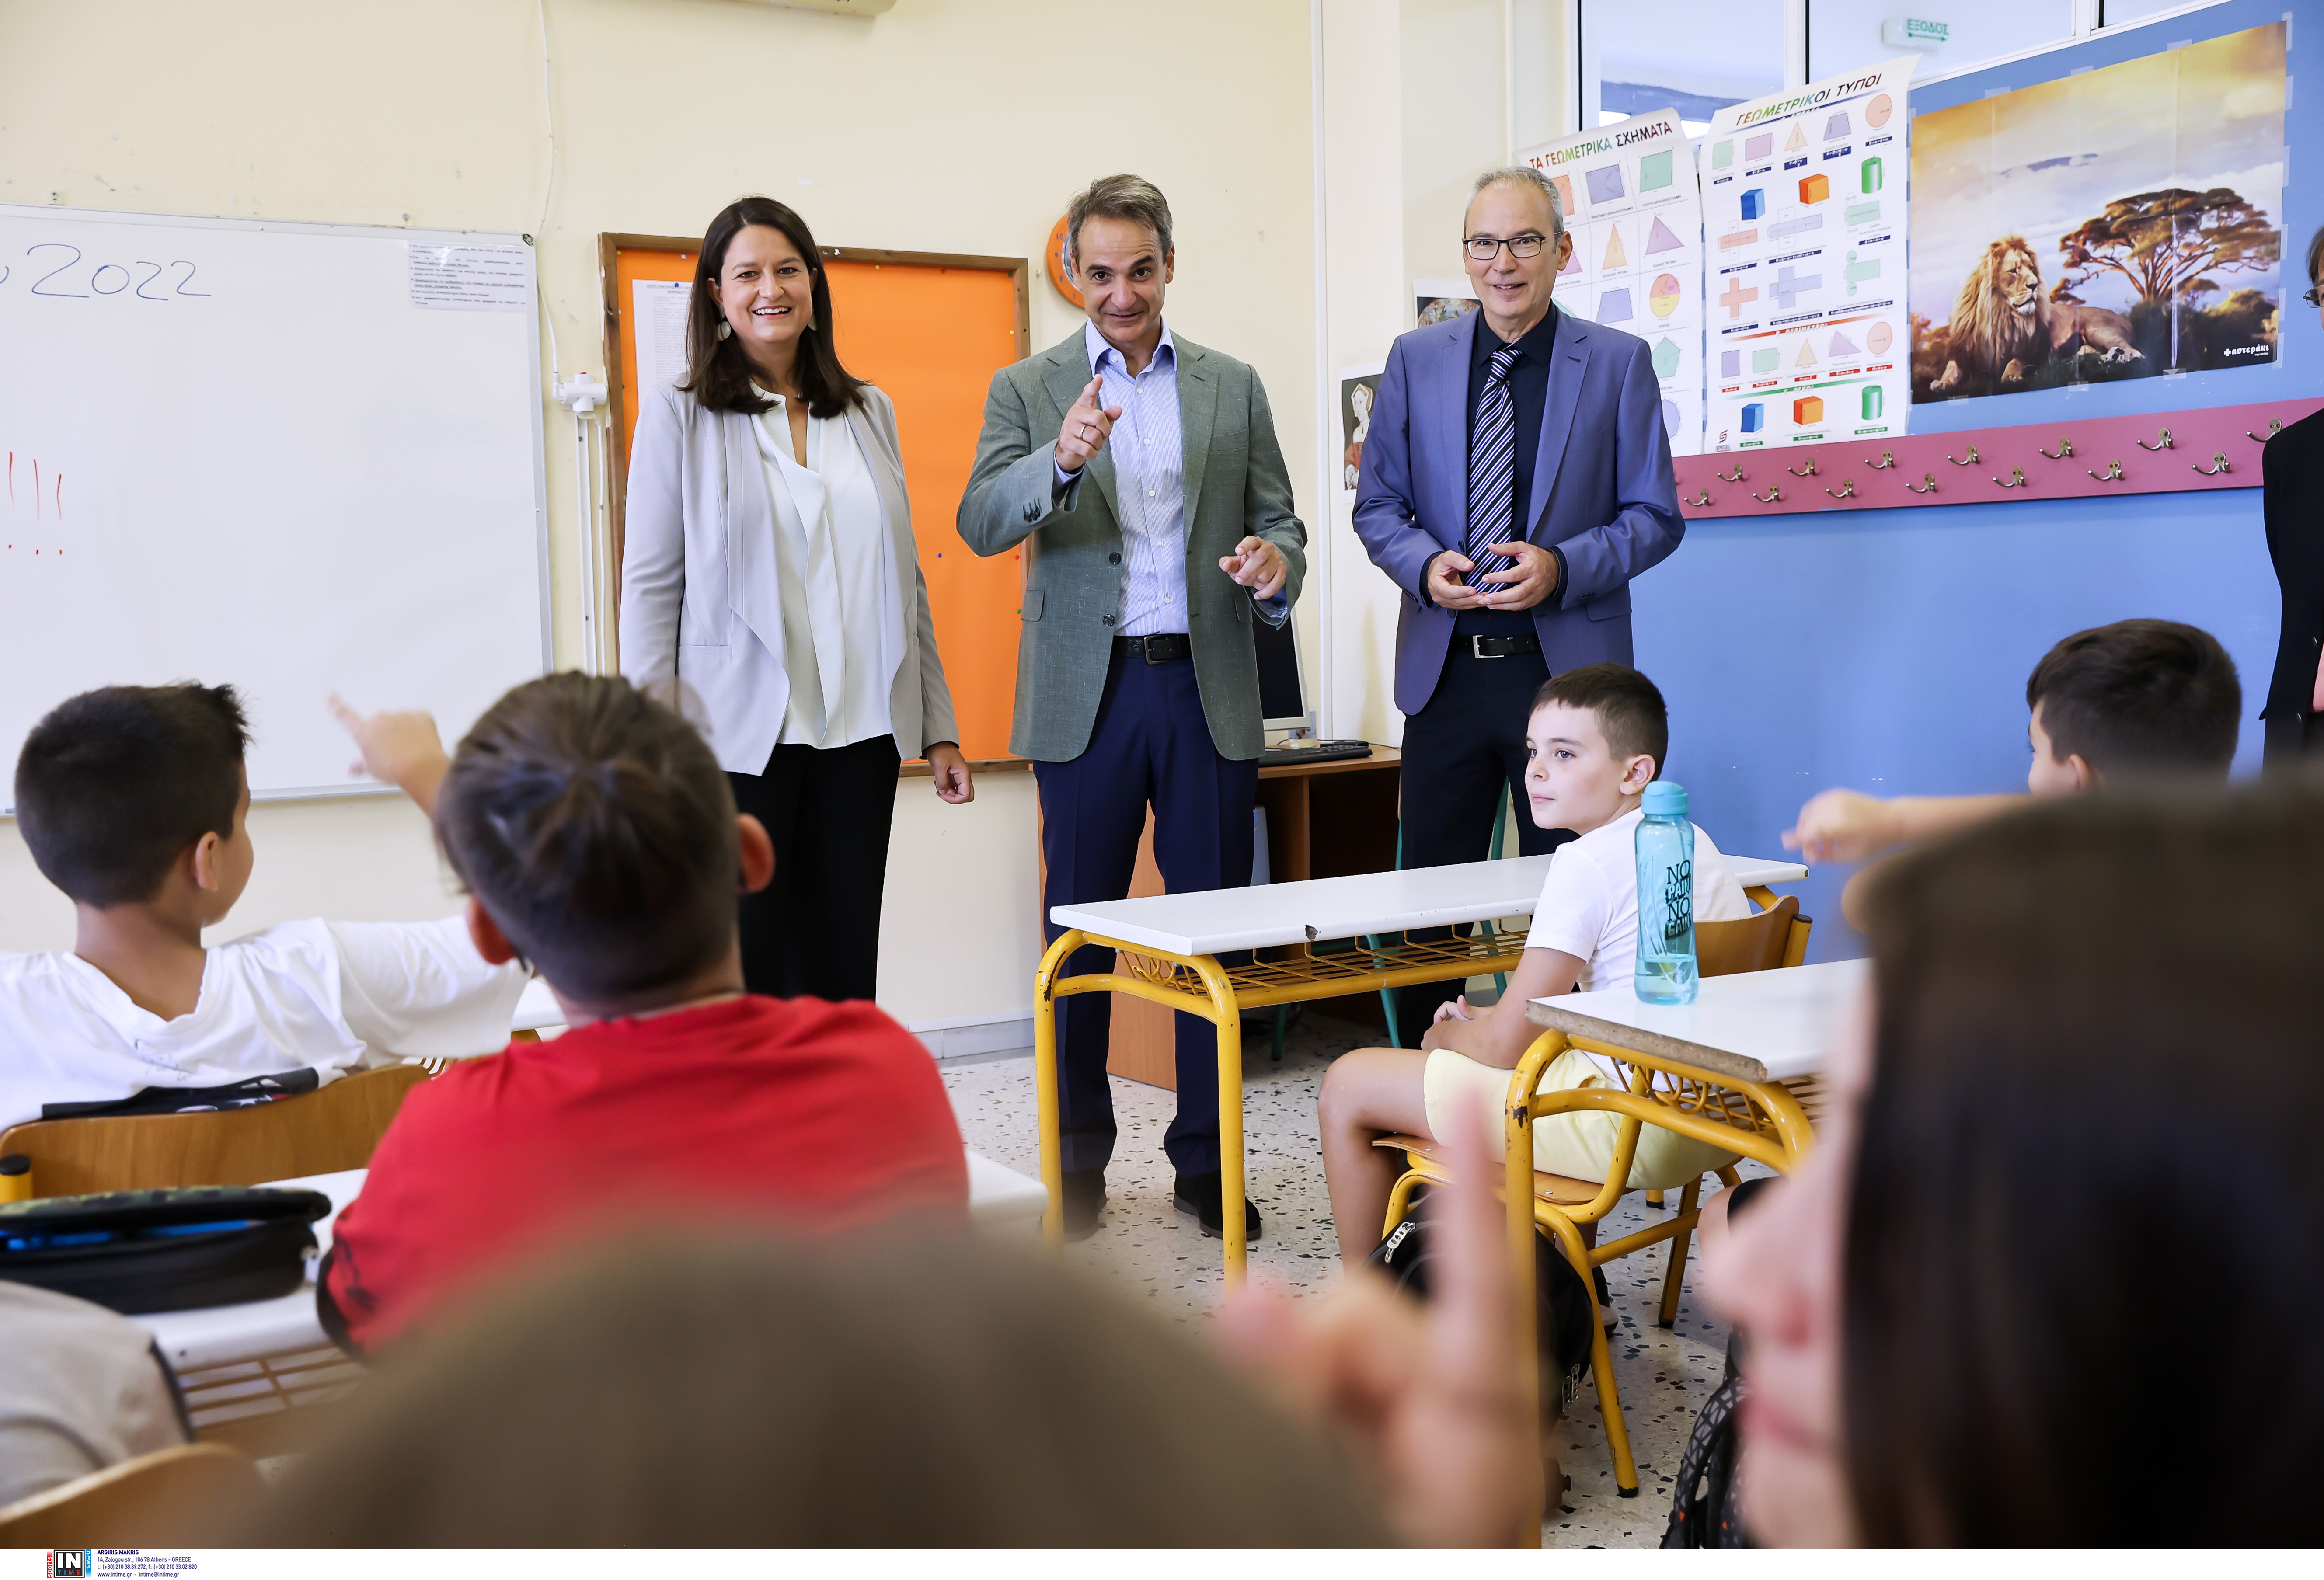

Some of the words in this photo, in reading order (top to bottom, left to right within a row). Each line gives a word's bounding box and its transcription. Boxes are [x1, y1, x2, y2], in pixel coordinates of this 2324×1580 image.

[1736, 89, 1831, 126] ΓΕΩΜΕΤΡΙΚΟΙ
[1837, 73, 1882, 97] ΤΥΠΟΙ
[1529, 157, 1543, 169] ΤΑ
[1545, 137, 1613, 167] ΓΕΩΜΕΤΡΙΚΑ
[1616, 121, 1673, 147] ΣΧΗΜΑΤΑ
[27, 244, 212, 301] 2022
[1666, 860, 1691, 884] NO
[1668, 876, 1691, 901] PAIN
[1667, 897, 1690, 922] NO
[1667, 915, 1691, 936] GAIN
